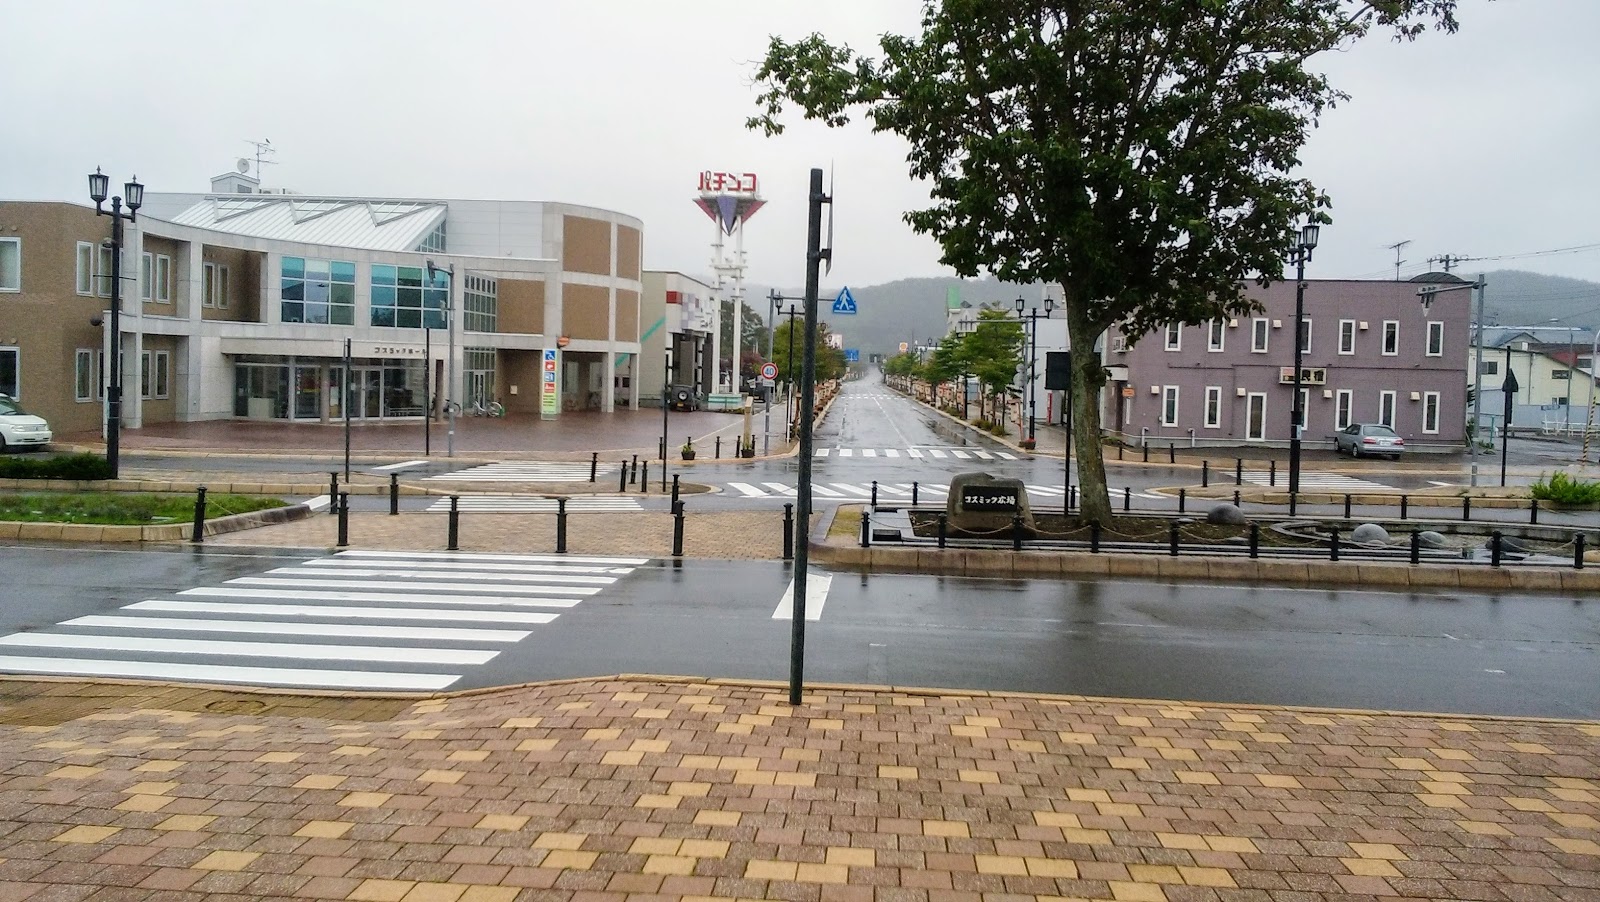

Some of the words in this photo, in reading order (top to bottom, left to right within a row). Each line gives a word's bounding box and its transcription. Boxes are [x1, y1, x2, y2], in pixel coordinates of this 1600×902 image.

[697, 170, 757, 191] パチンコ
[765, 367, 774, 375] 40
[964, 495, 1016, 505] コスミック広場
